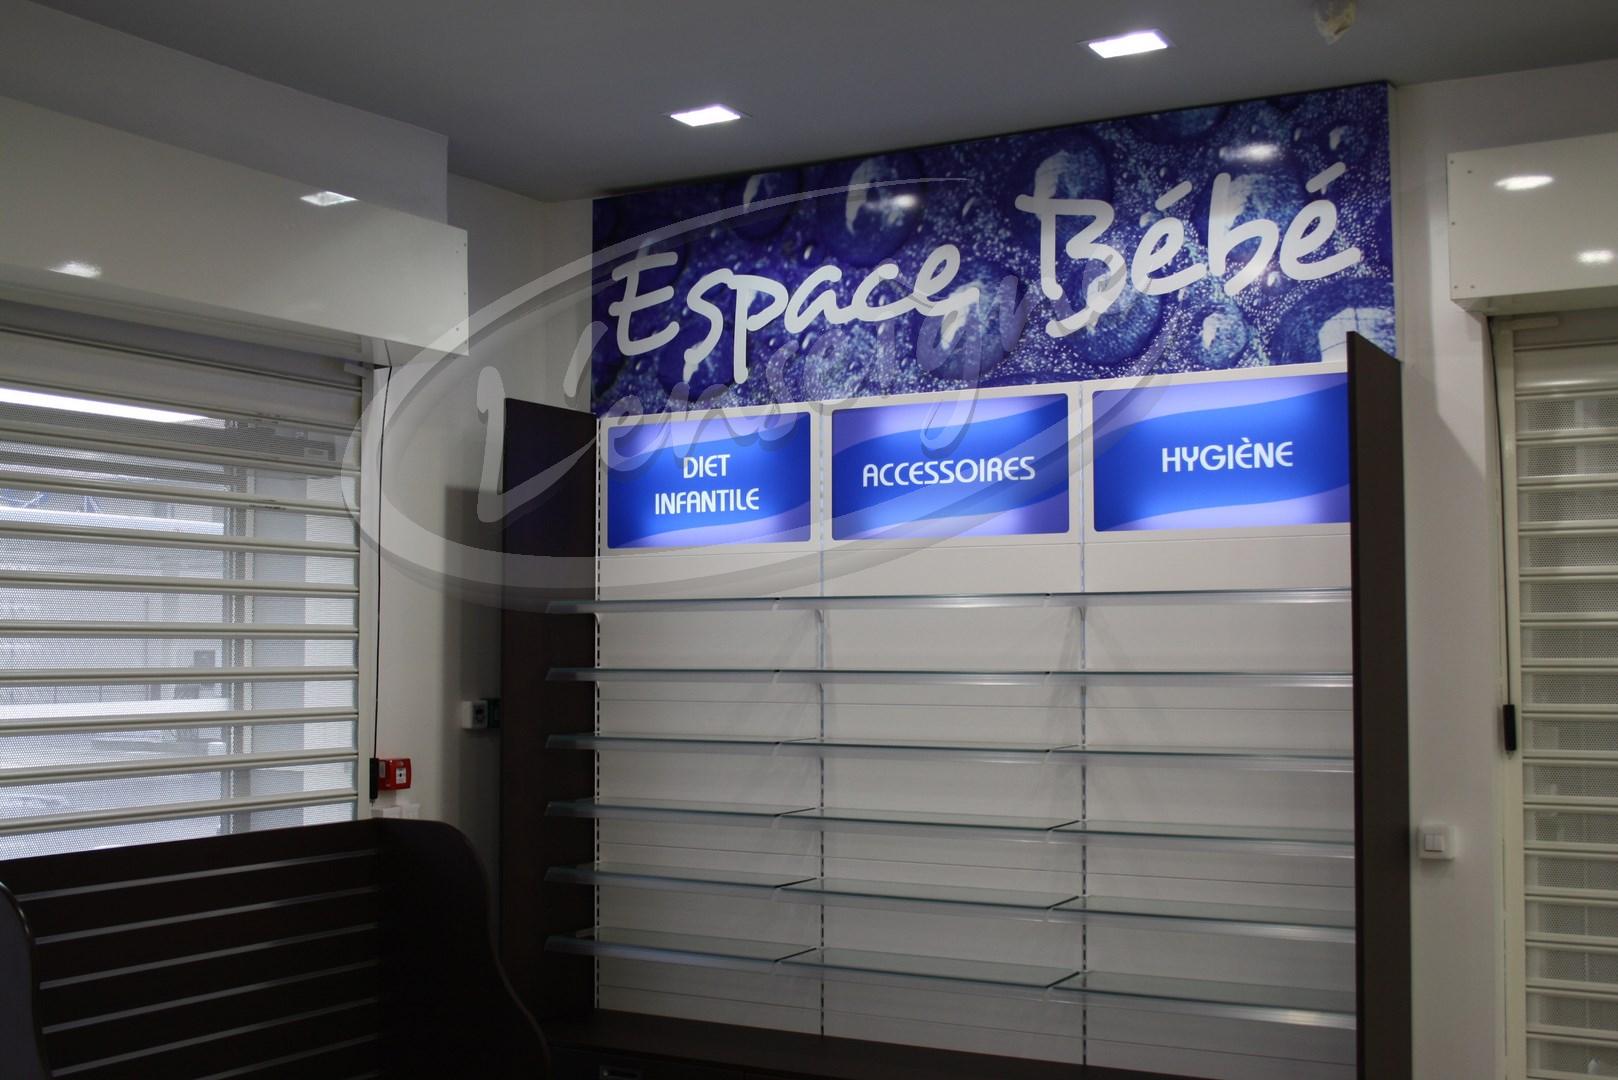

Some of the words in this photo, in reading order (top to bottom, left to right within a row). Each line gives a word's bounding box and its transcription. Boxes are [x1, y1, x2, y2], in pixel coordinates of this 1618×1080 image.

[608, 244, 979, 384] Espace
[1015, 161, 1361, 338] Bébé
[682, 453, 731, 480] DIET
[862, 455, 1037, 488] ACCESSOIRES
[1161, 436, 1294, 474] HYGIÈNE
[654, 487, 761, 516] INFANTILE
